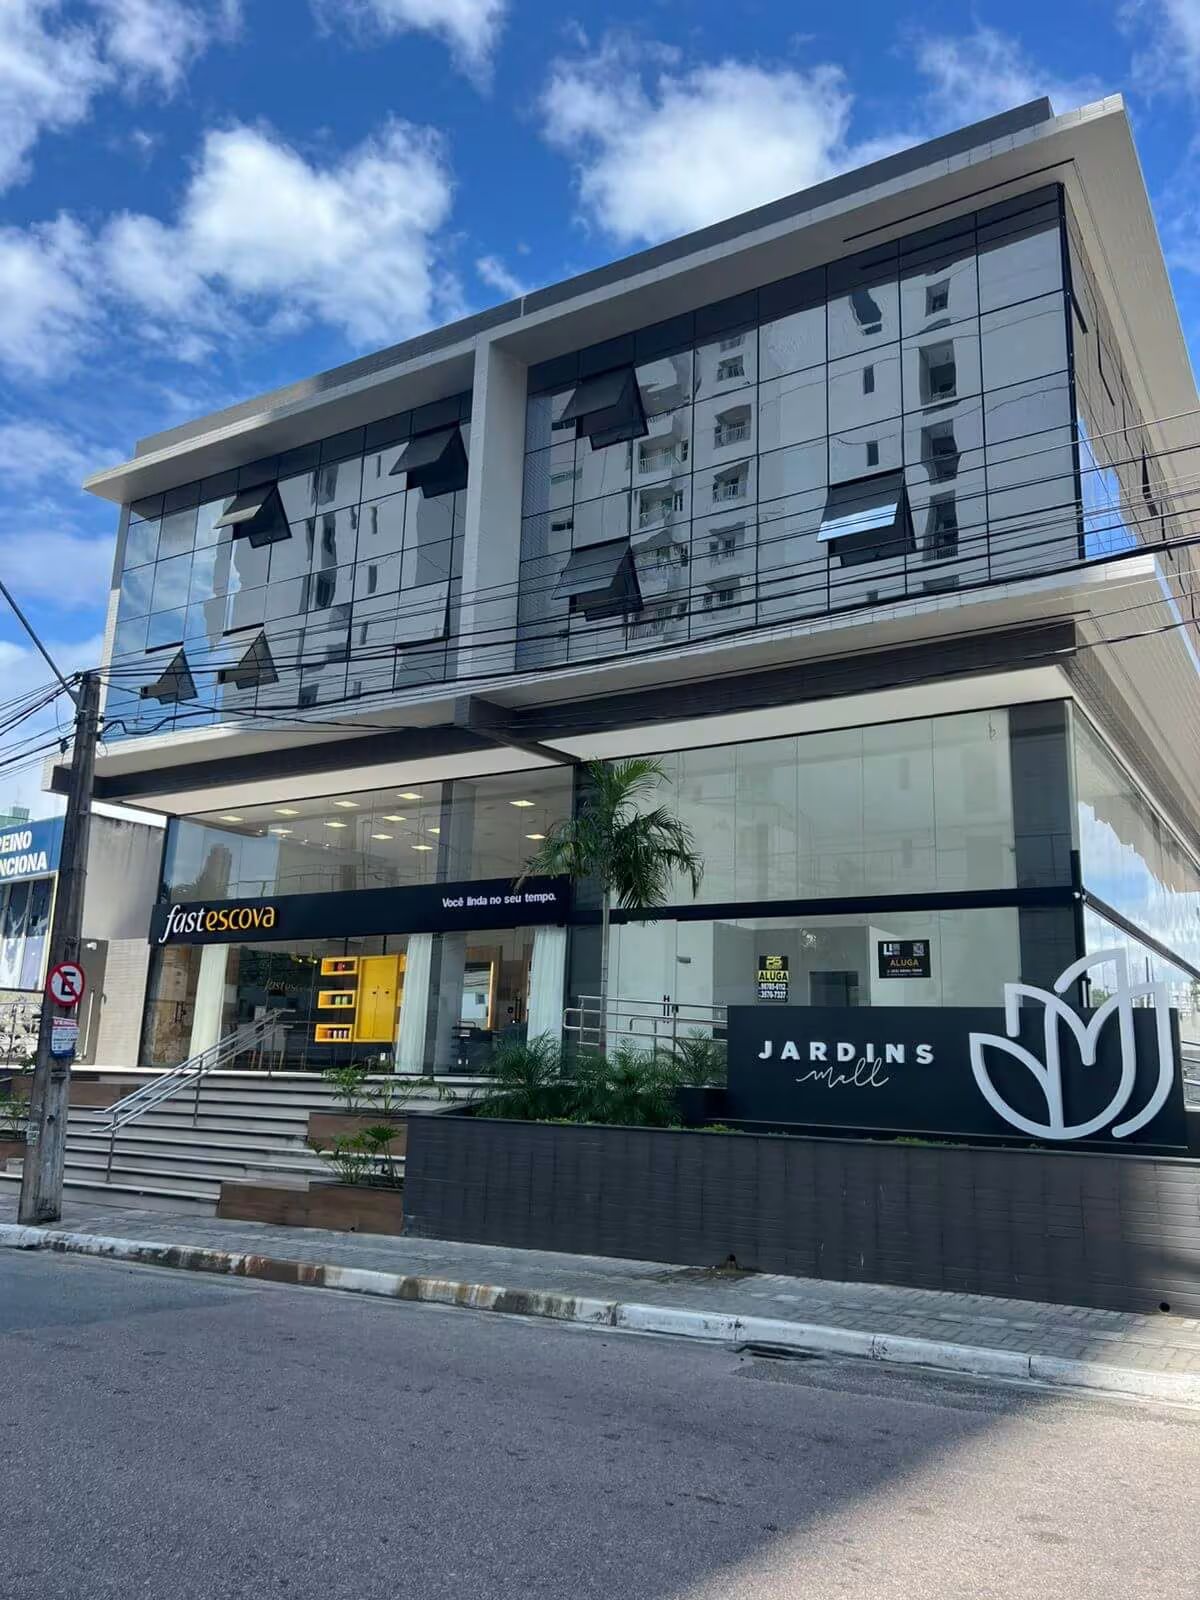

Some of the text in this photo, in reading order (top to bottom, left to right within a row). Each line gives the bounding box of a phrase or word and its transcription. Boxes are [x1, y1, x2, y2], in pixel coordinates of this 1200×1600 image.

[0, 830, 32, 853] EINO
[442, 893, 557, 908] Você linda no seu tempo.
[890, 959, 919, 967] ALUGA
[759, 971, 788, 981] ALUGA
[758, 1040, 934, 1065] JARDINS
